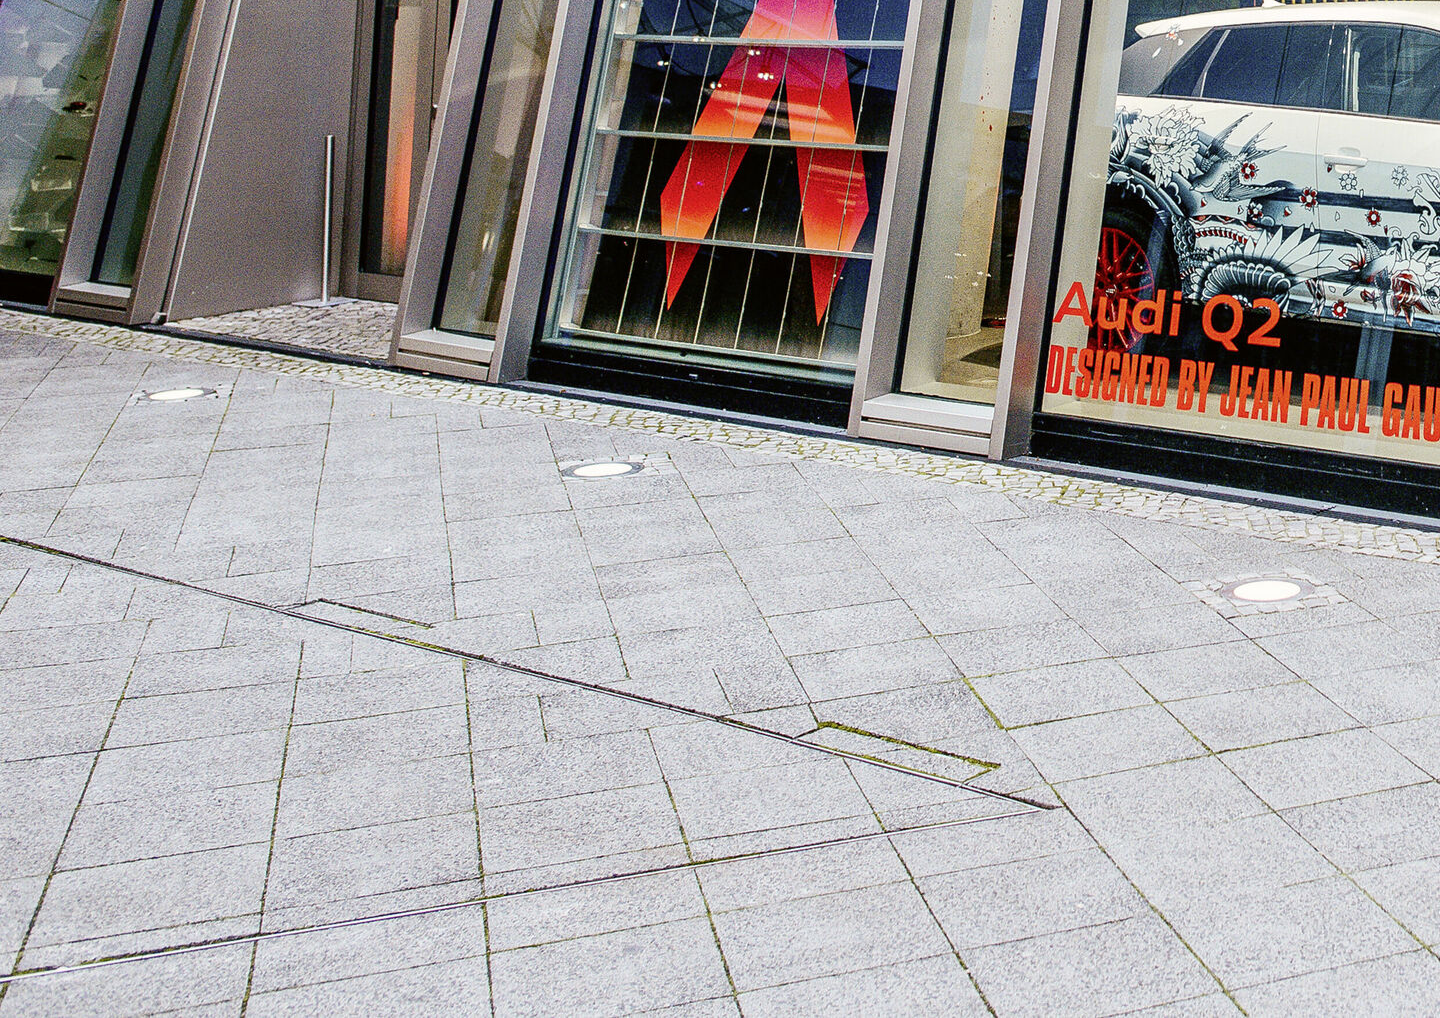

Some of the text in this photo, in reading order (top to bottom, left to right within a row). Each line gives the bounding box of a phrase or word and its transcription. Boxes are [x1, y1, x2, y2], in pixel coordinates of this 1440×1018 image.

[1052, 281, 1283, 352] Audi Q2
[1045, 344, 1170, 407] DESIGNED
[1178, 358, 1216, 415] BY
[1220, 364, 1292, 425] JEAN
[1300, 373, 1372, 435] PAUL
